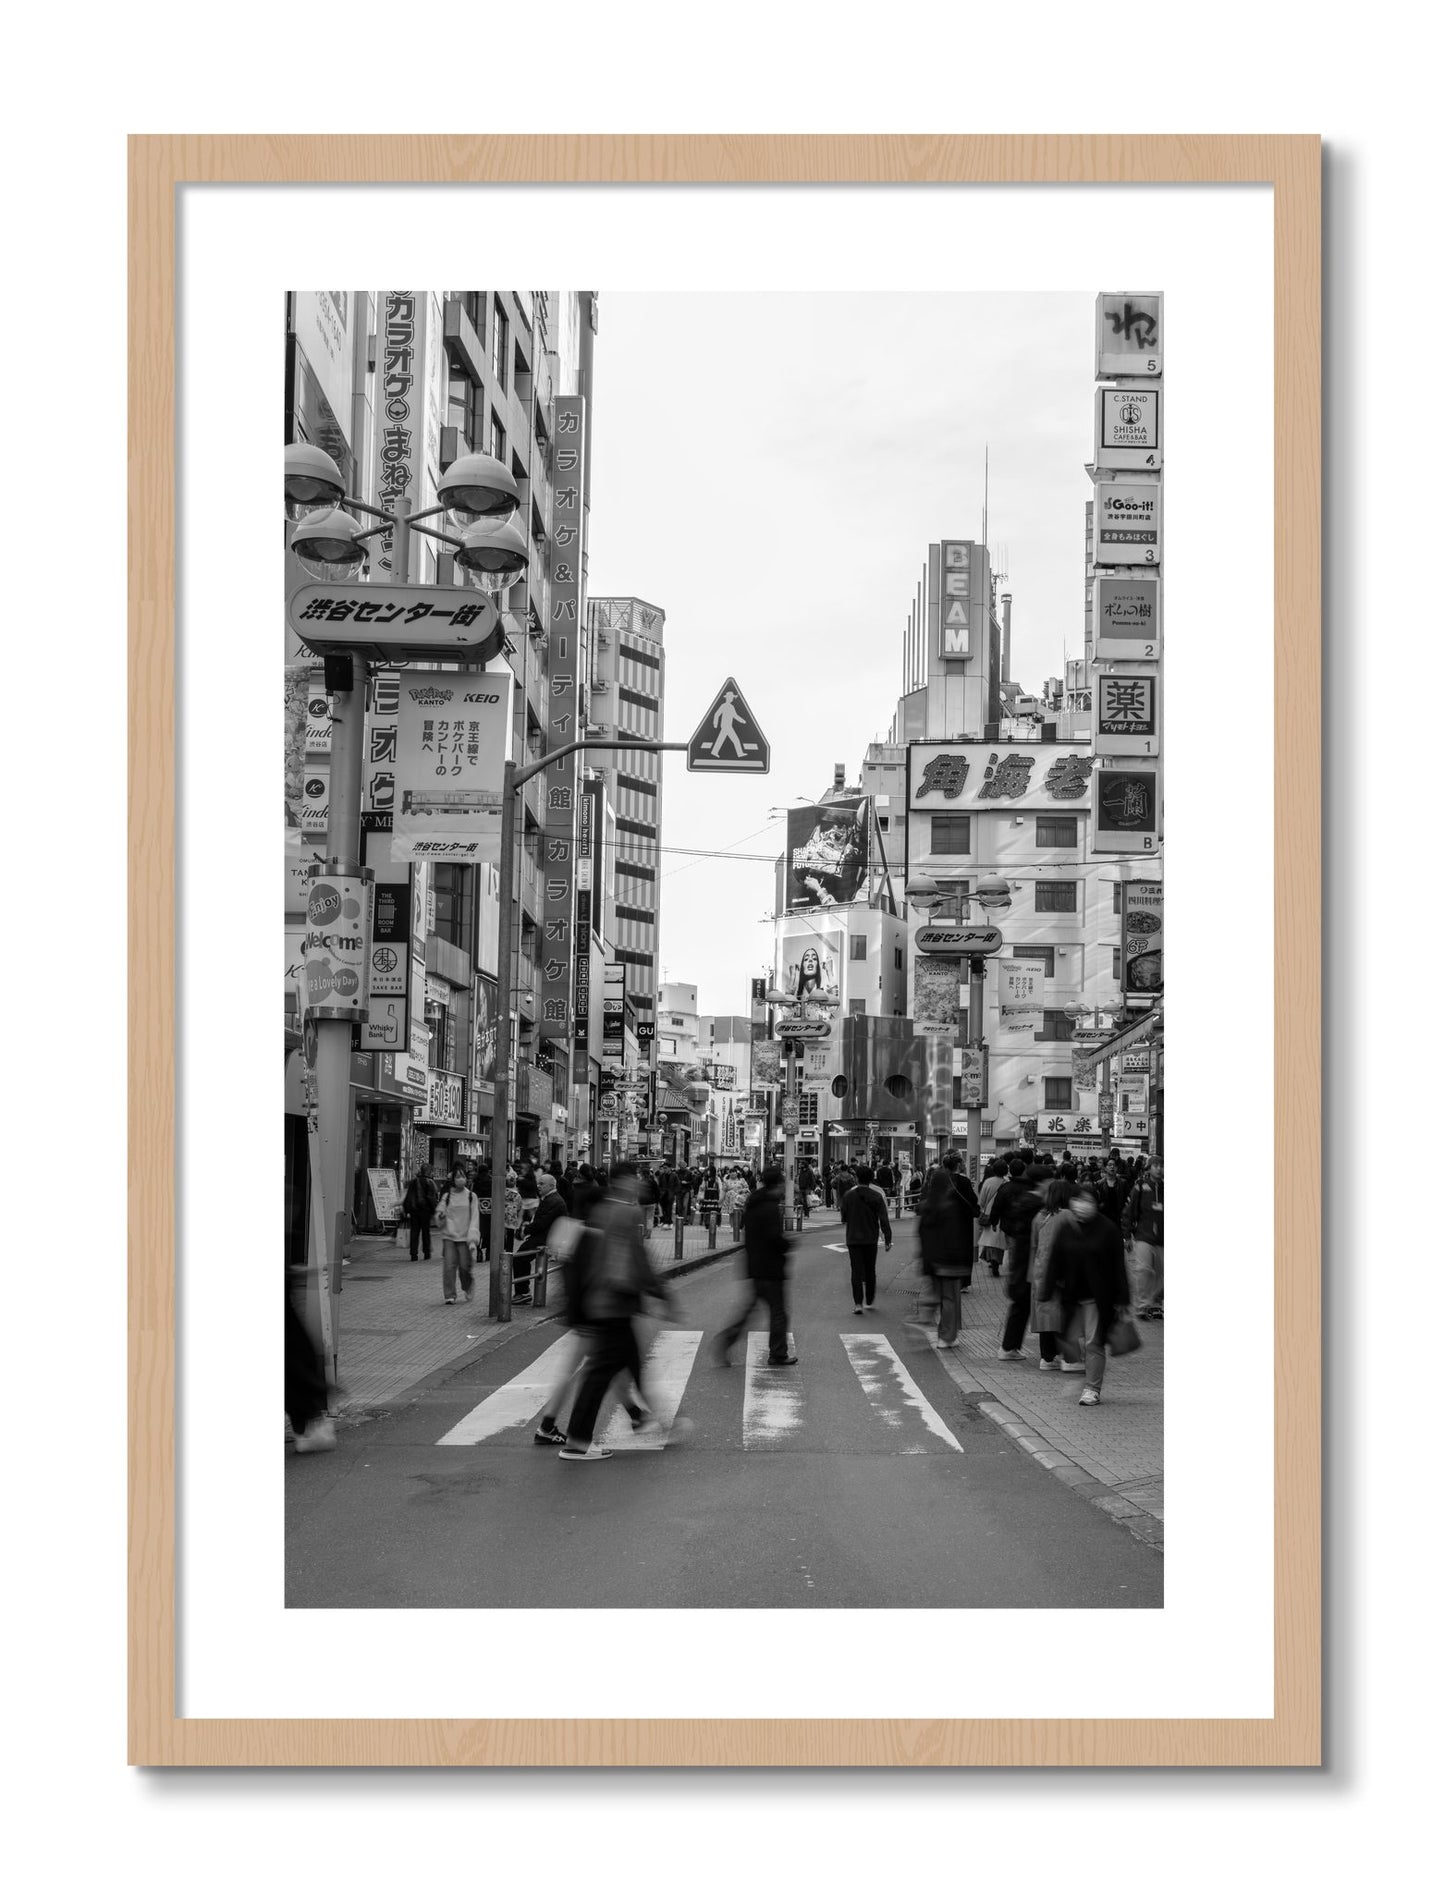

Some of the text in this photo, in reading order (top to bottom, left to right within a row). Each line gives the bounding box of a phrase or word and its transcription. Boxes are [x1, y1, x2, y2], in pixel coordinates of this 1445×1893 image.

[384, 296, 416, 400] カラオケ
[1147, 360, 1156, 371] 5
[1113, 425, 1148, 434] SHISHA
[1112, 498, 1154, 511] Goo-it!
[1103, 532, 1154, 542] 全身もみほぐし
[1145, 549, 1155, 562] 3
[944, 544, 970, 652] BEAM
[299, 598, 486, 627] 渋谷センター街
[1144, 645, 1154, 657] 2
[463, 693, 500, 704] KEIO
[1106, 681, 1145, 720] 薬
[421, 720, 434, 752] 冒険へ
[435, 720, 450, 776] カントーの
[467, 720, 480, 766] 京王線で
[1144, 741, 1151, 753] 1
[412, 841, 479, 852] 渋谷センター街
[1143, 837, 1153, 849] B
[308, 895, 340, 920] Enjoy
[543, 839, 571, 1022] カラオケ館
[305, 931, 364, 951] Welcome
[920, 932, 999, 943] 渋谷センター街
[1127, 940, 1149, 955] 6F
[369, 1024, 395, 1034] Whisky
[639, 1026, 654, 1035] GU
